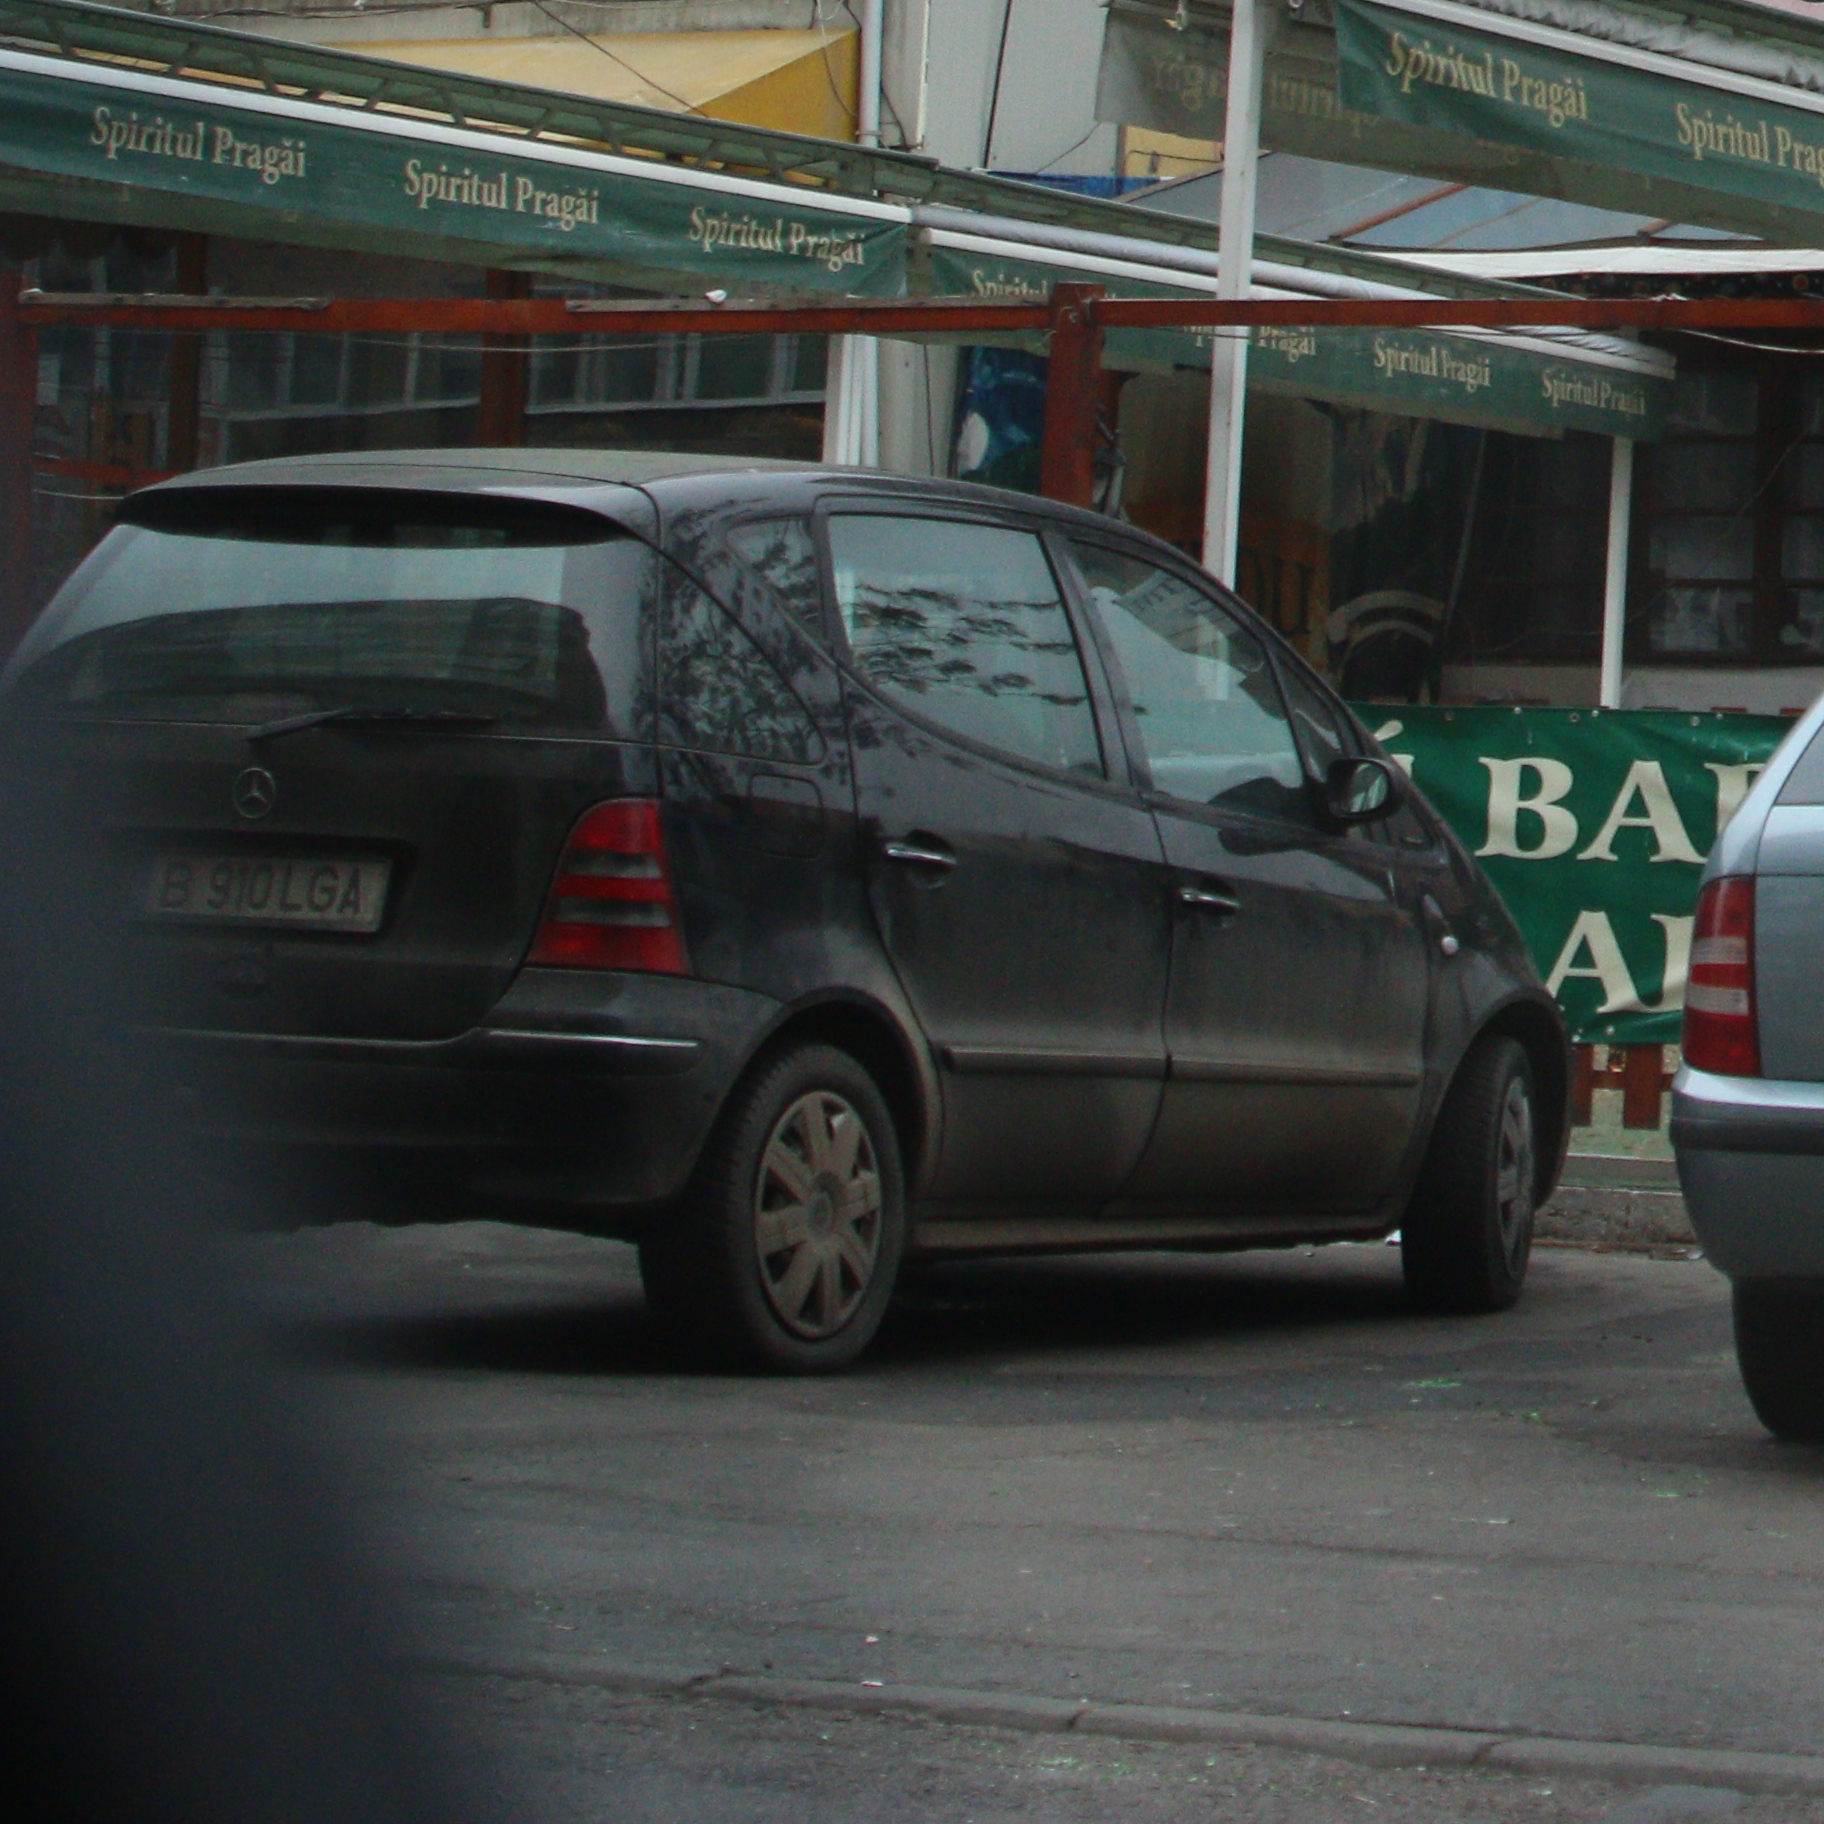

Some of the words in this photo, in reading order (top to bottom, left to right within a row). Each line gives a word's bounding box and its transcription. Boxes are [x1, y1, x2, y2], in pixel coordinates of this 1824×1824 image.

[1384, 31, 1499, 98] Spiritul
[1501, 58, 1588, 128] Pragăi
[90, 105, 205, 160] Spiritul
[211, 125, 306, 185] Pragăi
[1676, 101, 1770, 163] Spiritul
[404, 159, 508, 210] Spiritul
[515, 176, 599, 232] Pragăi
[689, 206, 783, 253] Spiritul
[158, 860, 193, 910] B
